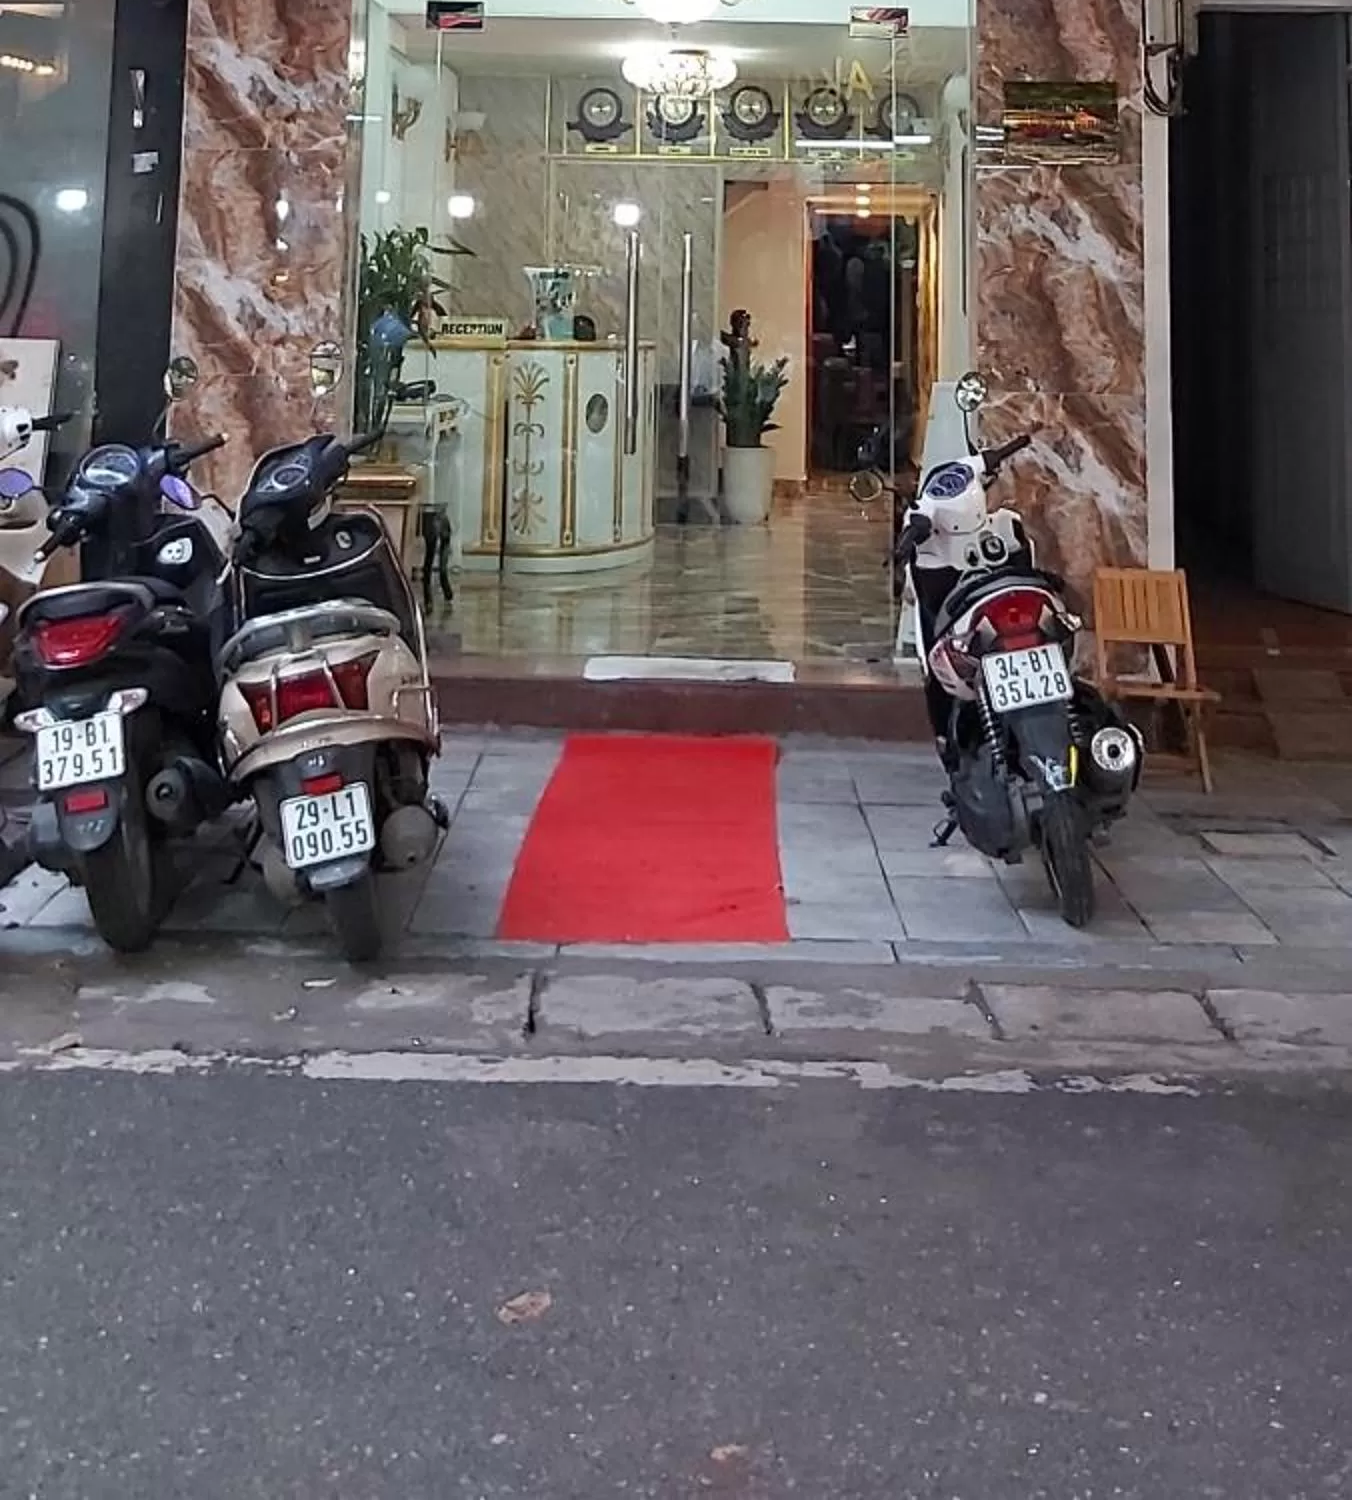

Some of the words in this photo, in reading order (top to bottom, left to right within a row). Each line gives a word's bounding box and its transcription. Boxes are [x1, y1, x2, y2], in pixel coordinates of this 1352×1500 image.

[441, 323, 503, 335] RECEPTION
[995, 650, 1053, 679] 34-B1
[995, 671, 1067, 707] 354.28
[51, 720, 107, 752] 19-B1
[43, 746, 117, 784] 379.51
[292, 819, 368, 861] 090.55
